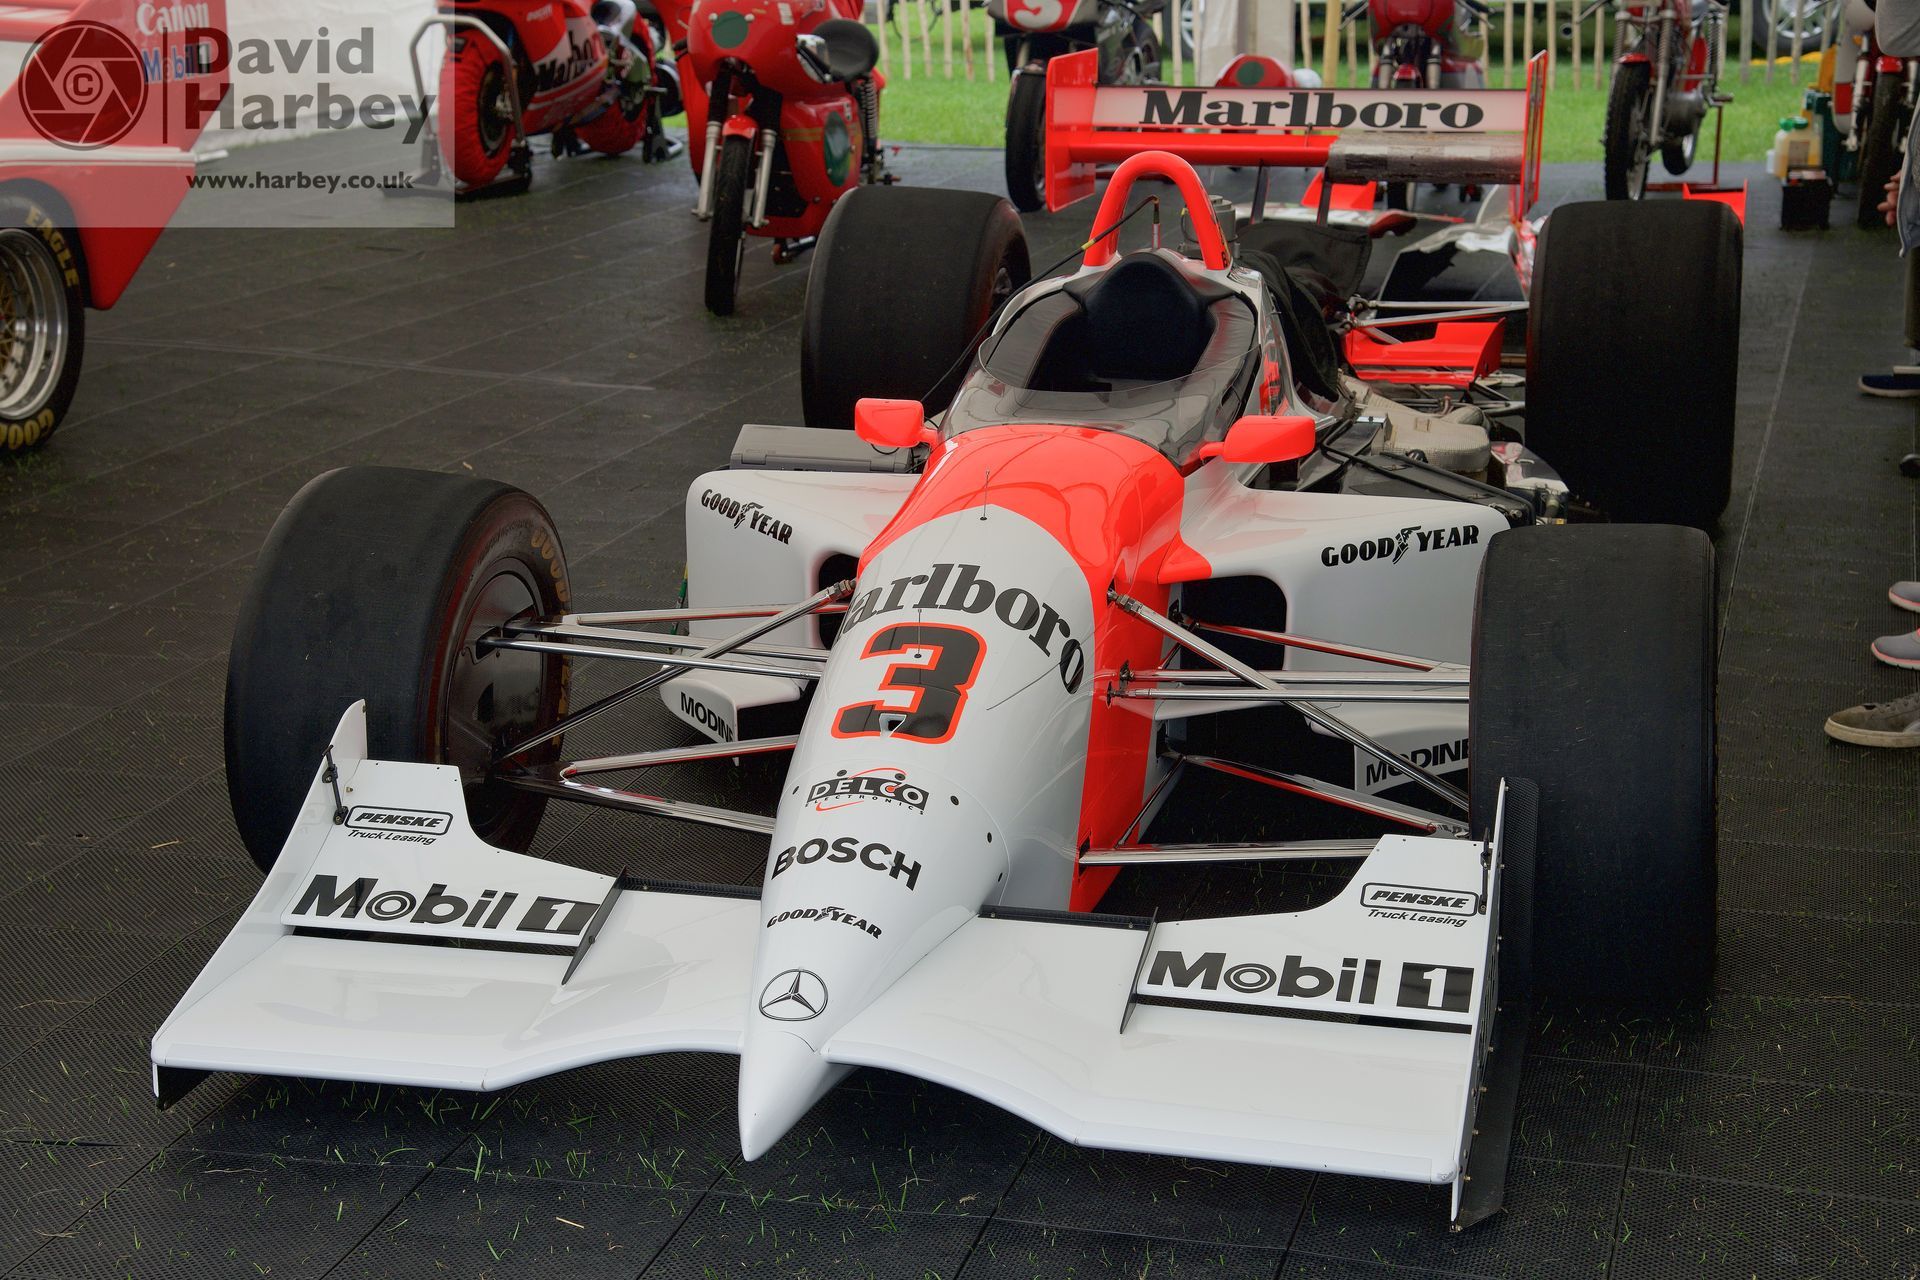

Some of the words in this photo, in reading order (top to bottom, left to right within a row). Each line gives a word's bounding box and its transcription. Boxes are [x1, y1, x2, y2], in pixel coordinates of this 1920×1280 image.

[136, 3, 210, 36] Canon
[1139, 90, 1484, 129] Marlboro
[26, 206, 80, 287] EAGLE
[833, 563, 1084, 694] arlboro
[831, 622, 988, 744] 3
[809, 778, 925, 806] DELCO
[347, 829, 386, 841] Truck
[384, 832, 437, 846] Leasing
[354, 812, 444, 829] PENSKE
[771, 836, 922, 891] BOSCH
[291, 874, 519, 930] Mobil
[1367, 908, 1410, 921] Truck
[1409, 912, 1468, 928] Leasing
[1369, 890, 1470, 909] PENSKE
[1146, 950, 1382, 1005] Mobil
